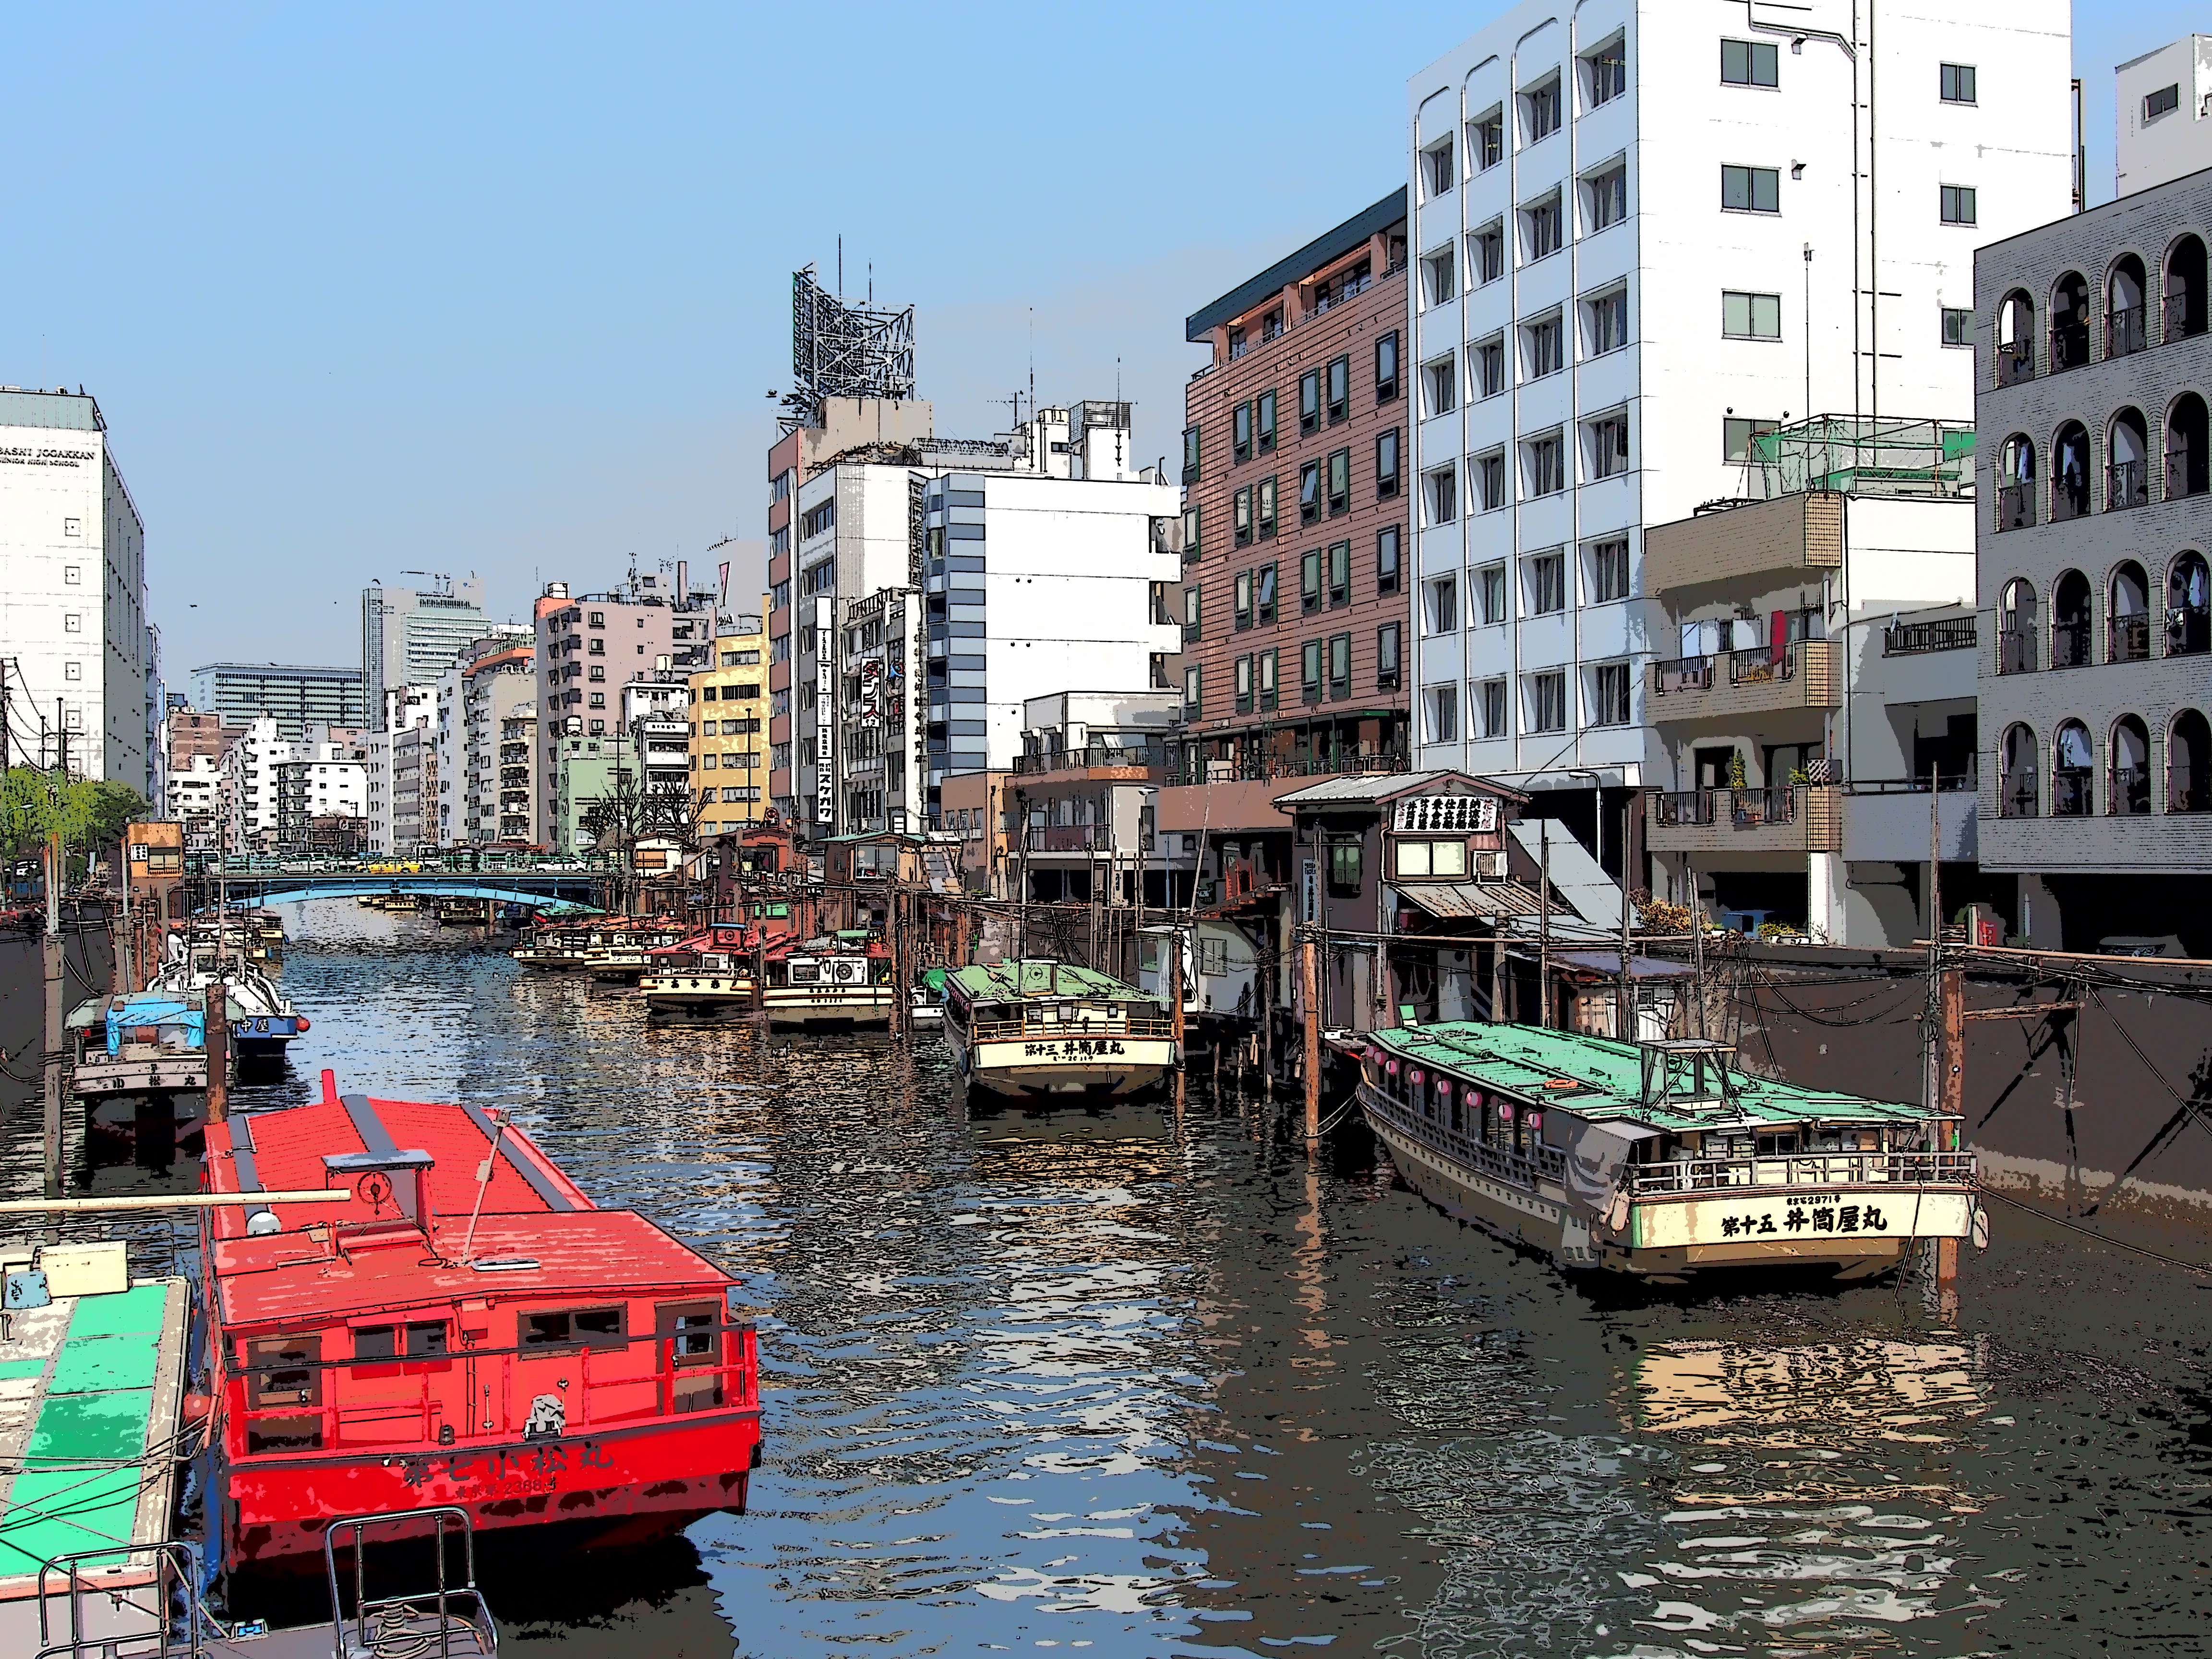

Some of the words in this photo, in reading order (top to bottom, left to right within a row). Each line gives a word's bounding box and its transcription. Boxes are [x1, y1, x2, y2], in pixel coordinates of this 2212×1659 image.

[819, 774, 831, 817] スケガワ
[1430, 798, 1443, 830] 乗合船
[1443, 799, 1456, 830] 仕立船
[1455, 798, 1467, 830] 屋形船
[1025, 1043, 1058, 1056] 第十三
[1062, 1040, 1125, 1056] 井筒屋丸
[1721, 1214, 1778, 1237] 第十五
[1783, 1205, 1887, 1233] 井筒屋丸
[403, 1441, 614, 1488] 第七小松丸
